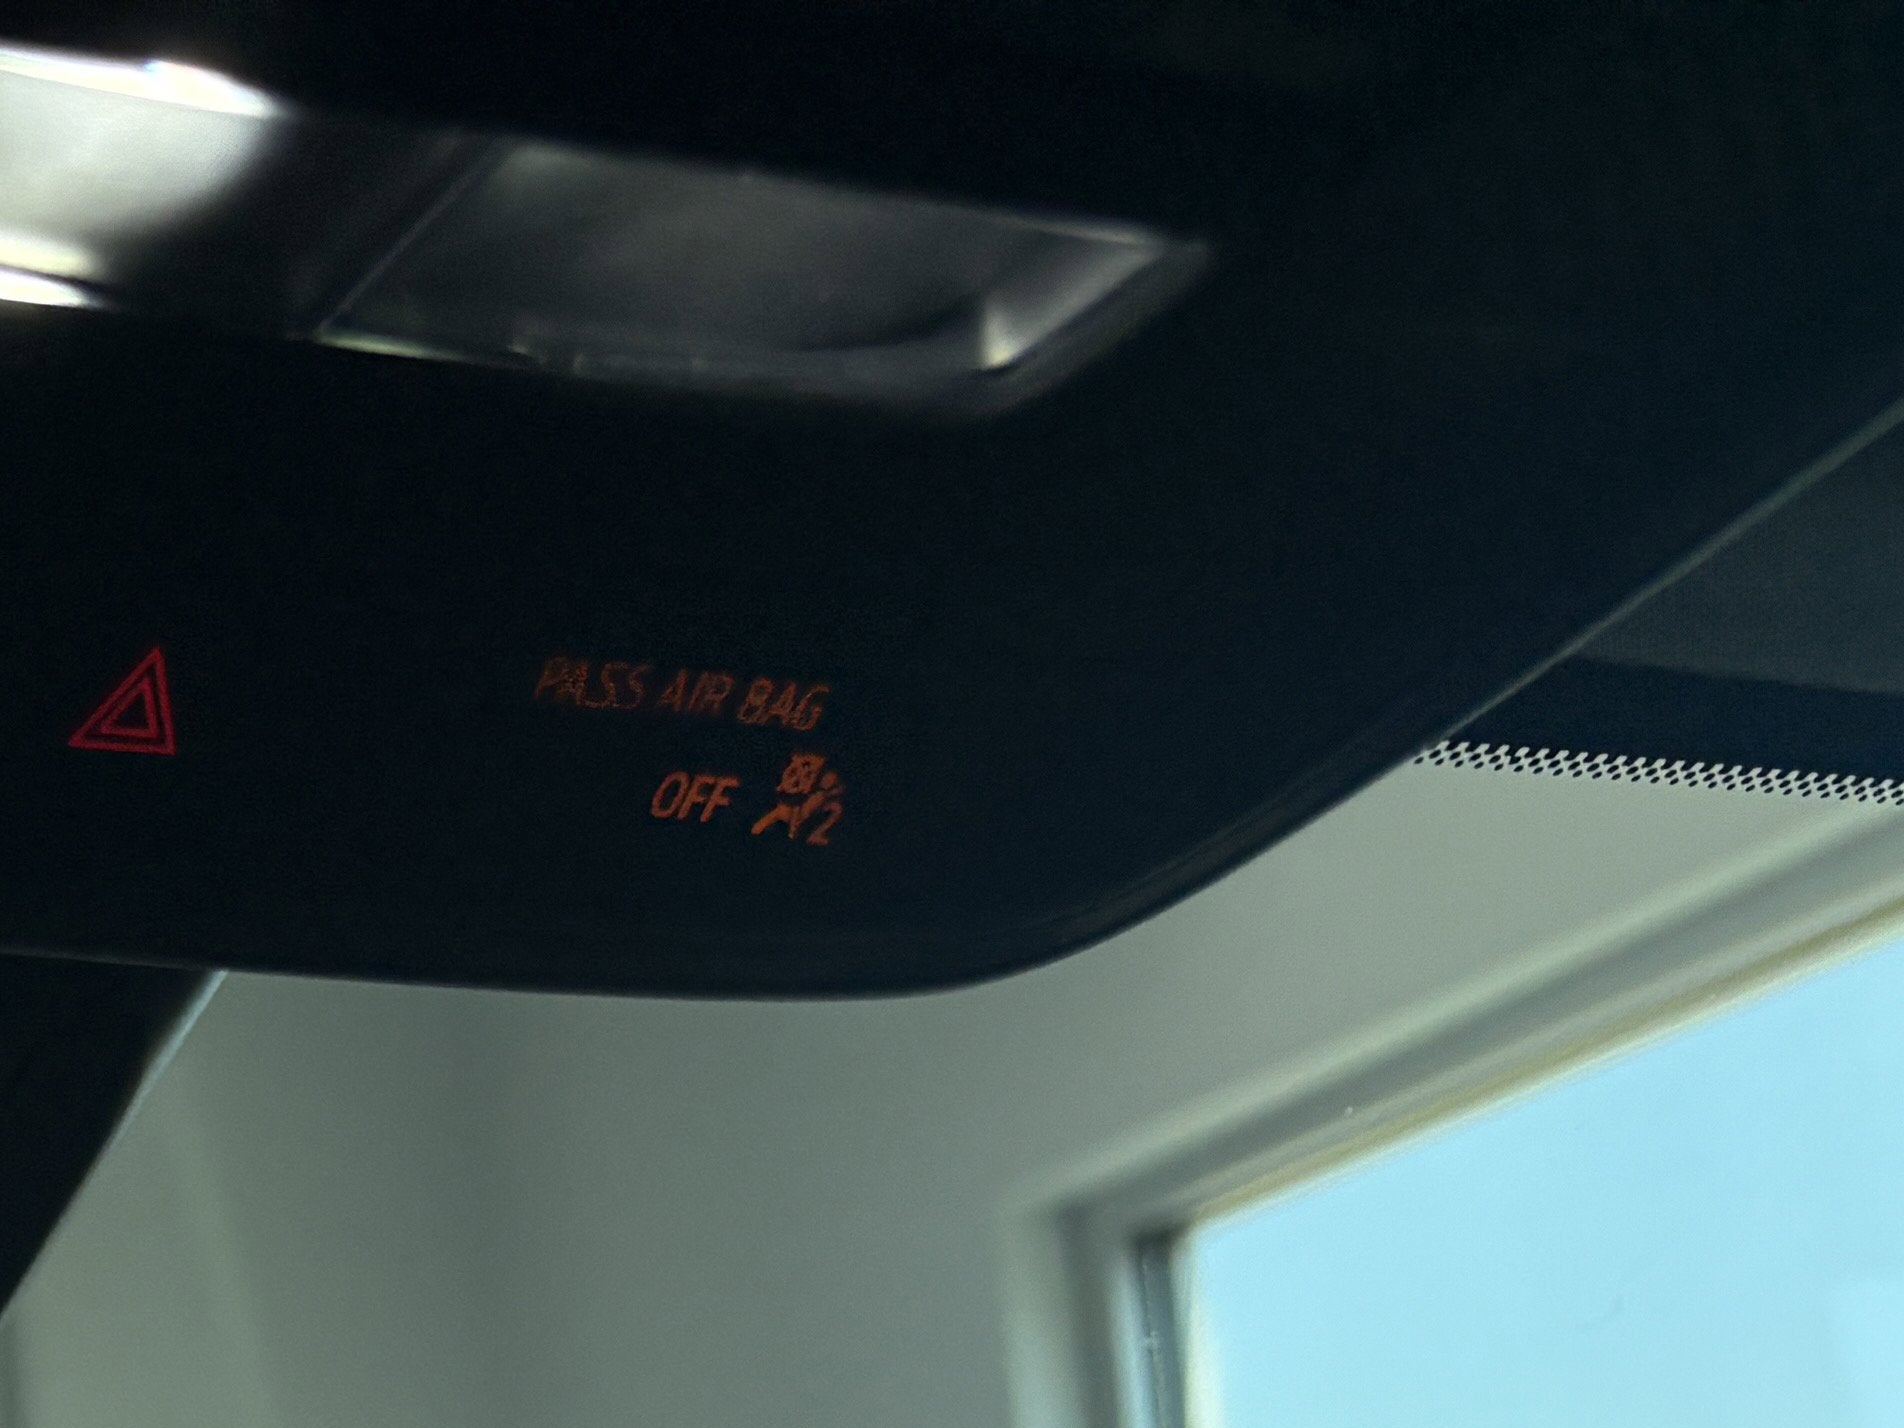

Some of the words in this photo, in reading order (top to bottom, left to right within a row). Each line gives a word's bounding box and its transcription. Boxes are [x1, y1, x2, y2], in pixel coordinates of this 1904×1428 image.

[533, 655, 652, 711] PASS
[657, 667, 735, 716] AIR
[737, 677, 831, 732] BAG
[650, 770, 741, 823] OFF
